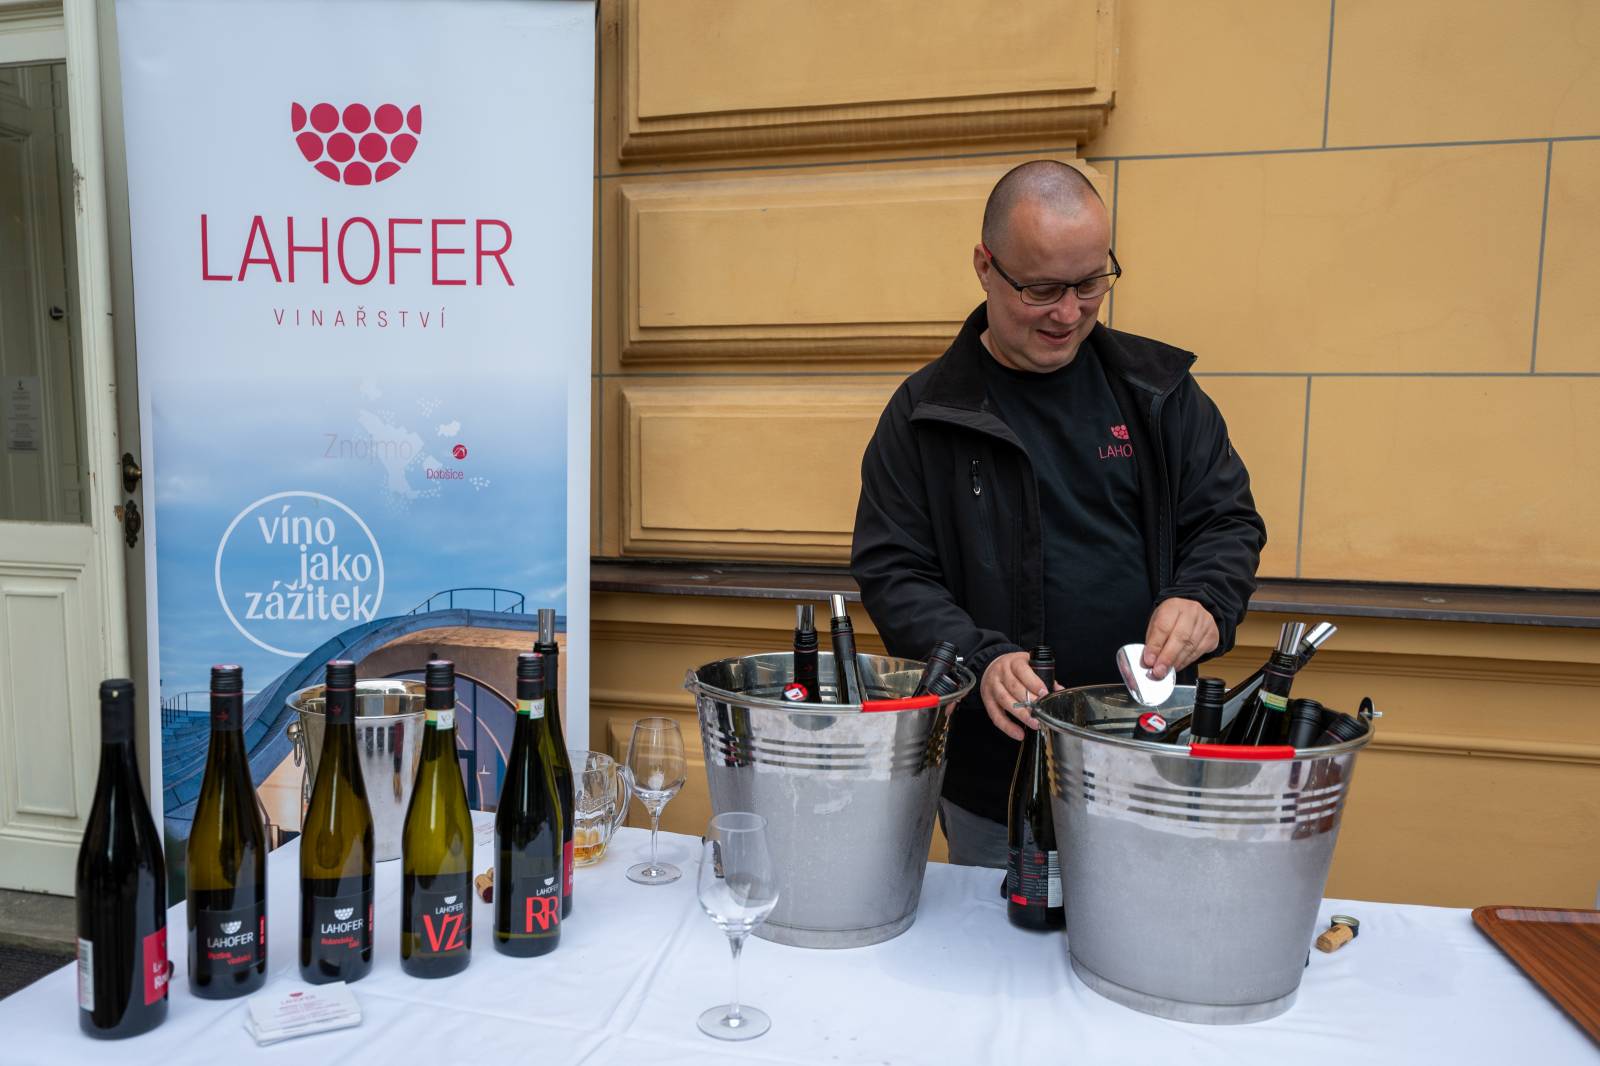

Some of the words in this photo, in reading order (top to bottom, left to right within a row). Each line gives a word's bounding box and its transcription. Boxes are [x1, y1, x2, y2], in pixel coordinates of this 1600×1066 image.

[200, 213, 516, 287] LAHOFER
[273, 305, 447, 329] VINAŘSTVÍ
[323, 433, 413, 465] Znojmo
[426, 467, 465, 480] Dobšice
[258, 504, 336, 545] víno
[298, 543, 372, 589] jako
[244, 579, 374, 622] zážitek
[321, 918, 364, 934] LAHOFER
[423, 912, 465, 952] VZ
[525, 895, 560, 933] RR
[207, 931, 254, 948] LAHOFER
